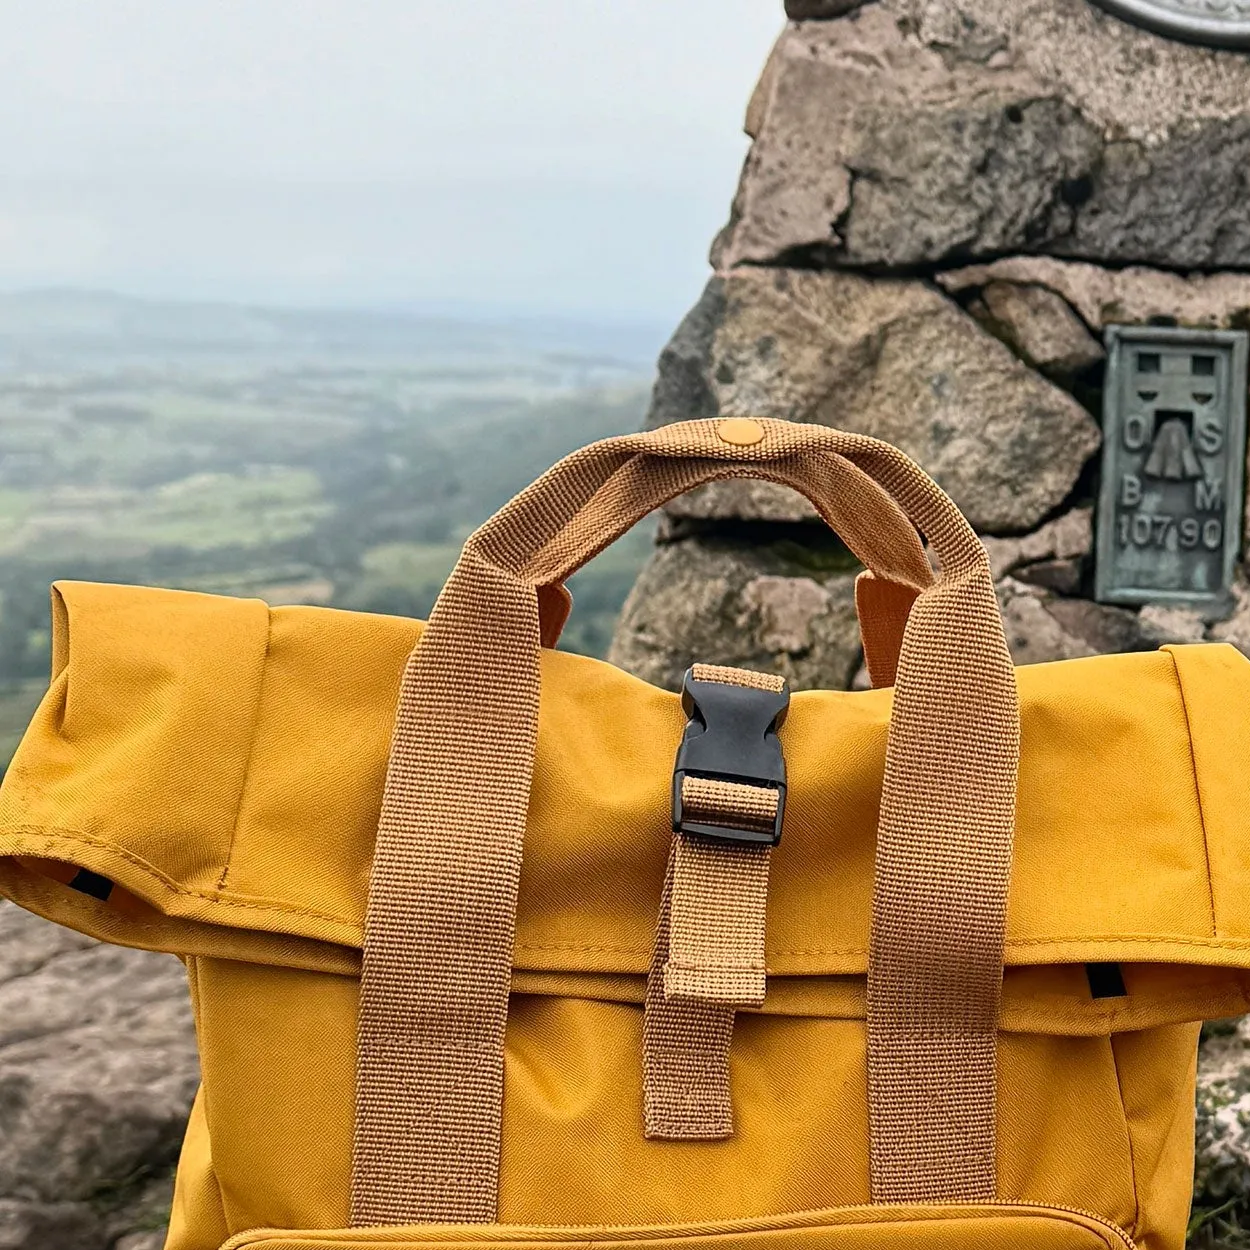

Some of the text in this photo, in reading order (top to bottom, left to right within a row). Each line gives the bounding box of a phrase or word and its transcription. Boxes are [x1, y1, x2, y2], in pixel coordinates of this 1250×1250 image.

[1123, 414, 1222, 453] O S
[1122, 474, 1221, 511] B M
[1118, 513, 1222, 549] 10790
